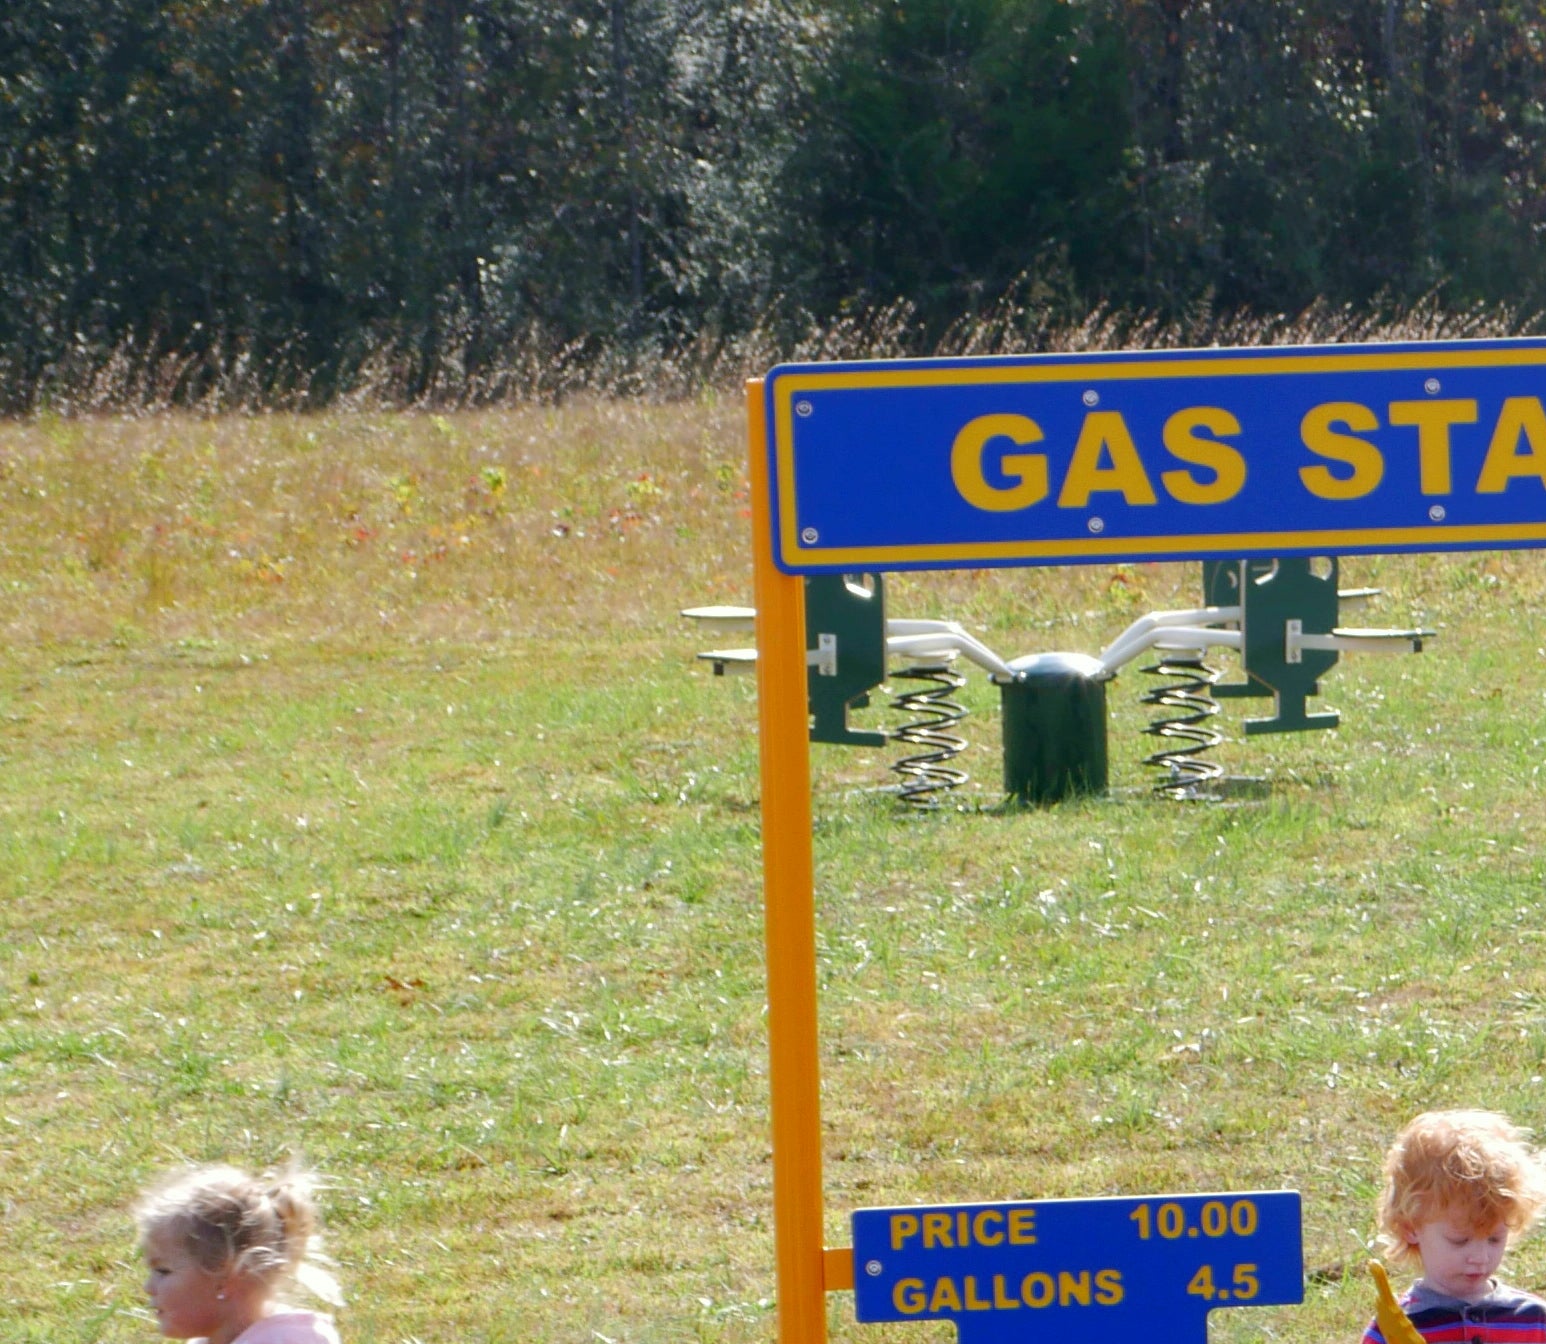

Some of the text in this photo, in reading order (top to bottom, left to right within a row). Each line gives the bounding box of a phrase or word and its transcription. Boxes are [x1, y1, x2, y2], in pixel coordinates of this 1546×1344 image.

[949, 406, 1247, 512] GAS
[890, 1199, 1258, 1250] PRICE 10.00
[892, 1263, 1259, 1315] GALLONS 4.5
